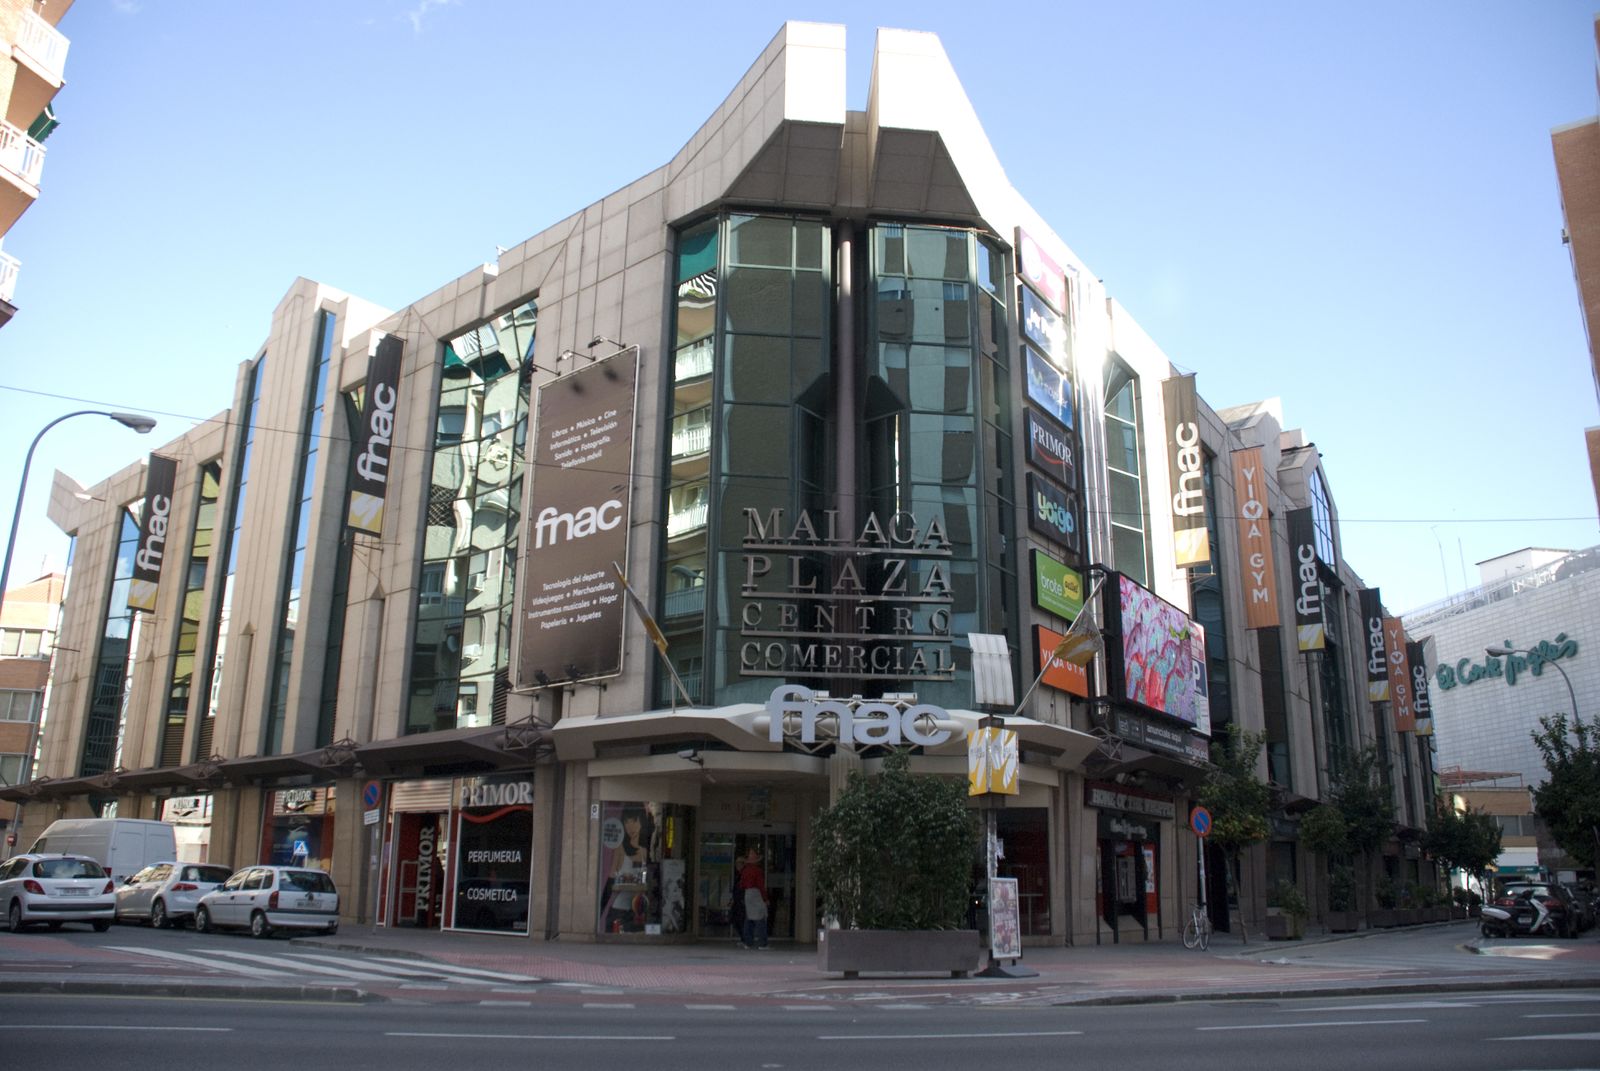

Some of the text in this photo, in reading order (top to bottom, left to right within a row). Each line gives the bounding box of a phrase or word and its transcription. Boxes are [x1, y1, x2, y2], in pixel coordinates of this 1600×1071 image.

[357, 382, 396, 483] fnac
[549, 421, 618, 451] Informática Televisión
[551, 409, 617, 439] Libros Música Cine
[554, 436, 611, 461] Sonido Fotografía
[586, 449, 603, 461] móvil
[1032, 420, 1073, 466] PRIMOR
[1173, 421, 1205, 517] fnac
[534, 500, 624, 549] fnac
[743, 507, 953, 547] MALAGA
[1037, 490, 1074, 535] yoigo
[136, 494, 171, 572] fnac
[543, 571, 606, 591] Tecnología del deporte
[741, 555, 955, 594] PLAZA
[1296, 543, 1322, 616] fnac
[527, 593, 619, 619] Instrumentos musicales Hogar
[532, 582, 616, 606] Videojuegos Merchandising
[540, 611, 602, 630] Papelería Juguetes
[741, 601, 951, 633] CENTRO
[740, 641, 956, 672] COMERCIAL
[1368, 615, 1388, 675] fnac
[1412, 664, 1430, 714] fnac
[1435, 662, 1457, 690] El
[1456, 655, 1503, 685] Corte
[765, 684, 953, 746] fnac
[461, 780, 534, 809] PRIMOR
[416, 825, 436, 912] PRIMOR
[467, 849, 521, 864] PERFUMERIA
[467, 887, 518, 902] COSMETICA
